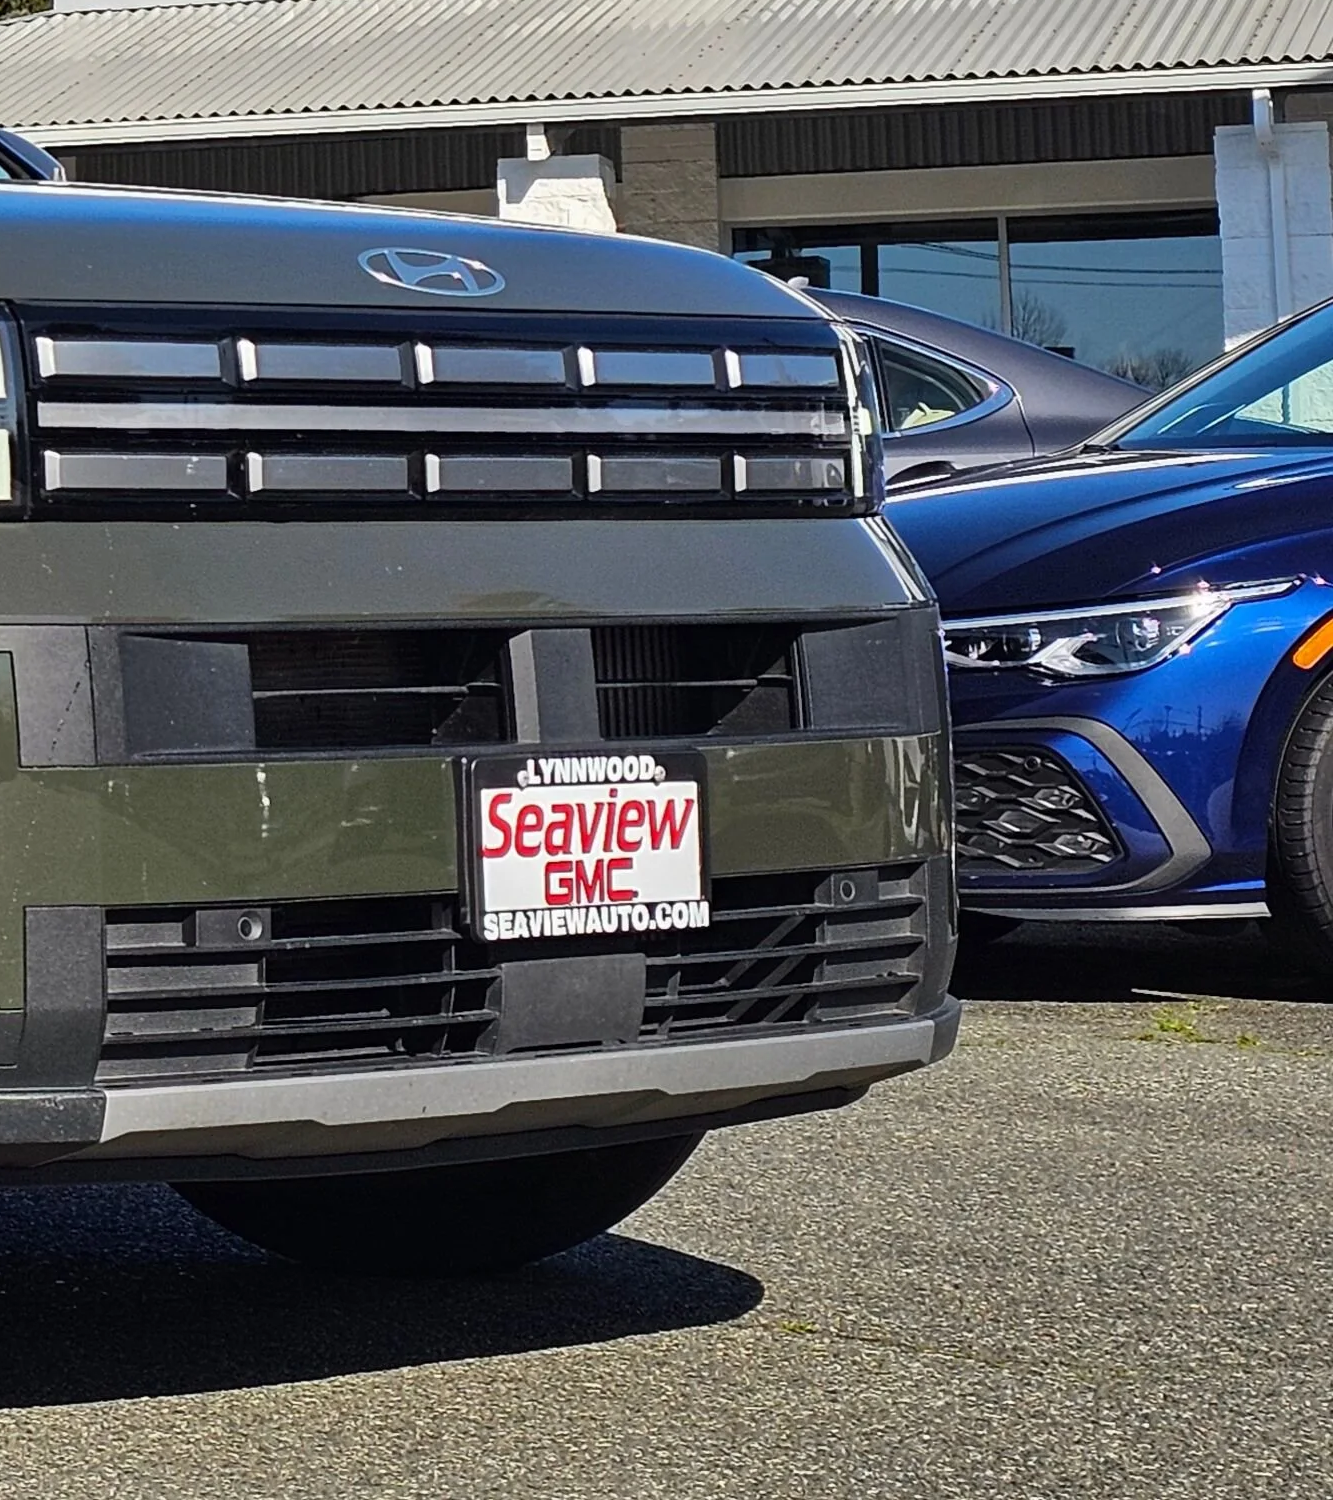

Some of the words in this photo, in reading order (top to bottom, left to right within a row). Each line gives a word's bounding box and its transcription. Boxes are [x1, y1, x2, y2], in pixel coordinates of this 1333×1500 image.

[526, 755, 655, 784] LYNNWOOD
[480, 788, 695, 859] Seaview
[544, 857, 639, 906] GMC
[483, 901, 710, 942] SEAVIEWAUTO.COM
